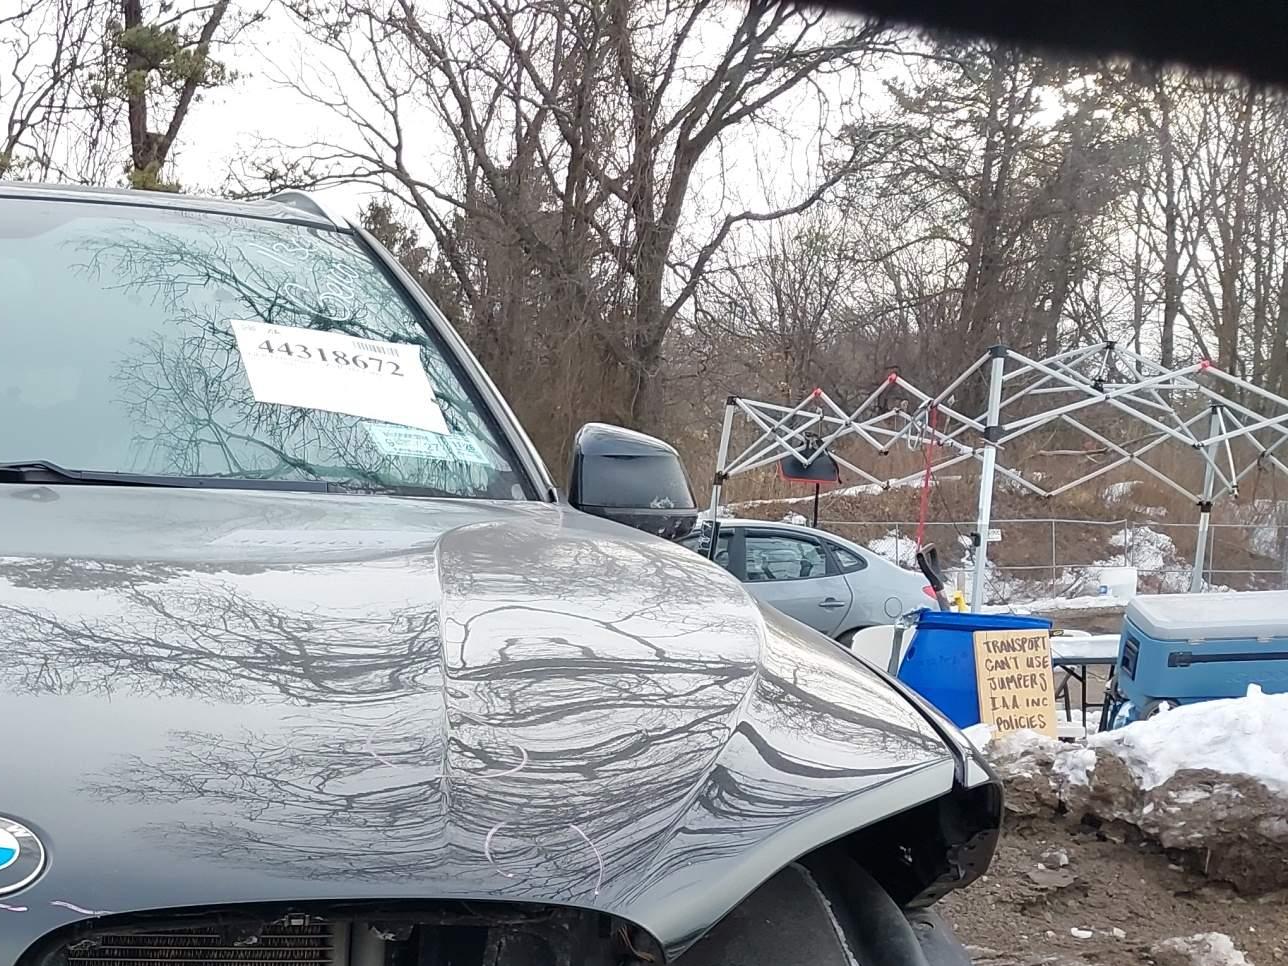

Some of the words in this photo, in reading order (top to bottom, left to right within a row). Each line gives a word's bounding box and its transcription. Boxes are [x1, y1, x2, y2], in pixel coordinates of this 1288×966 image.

[258, 339, 404, 377] 44318672
[983, 636, 1047, 654] TRANSPORT
[985, 656, 1019, 672] CAN'T
[1026, 655, 1049, 669] USE
[987, 673, 1047, 691] JUMPERS
